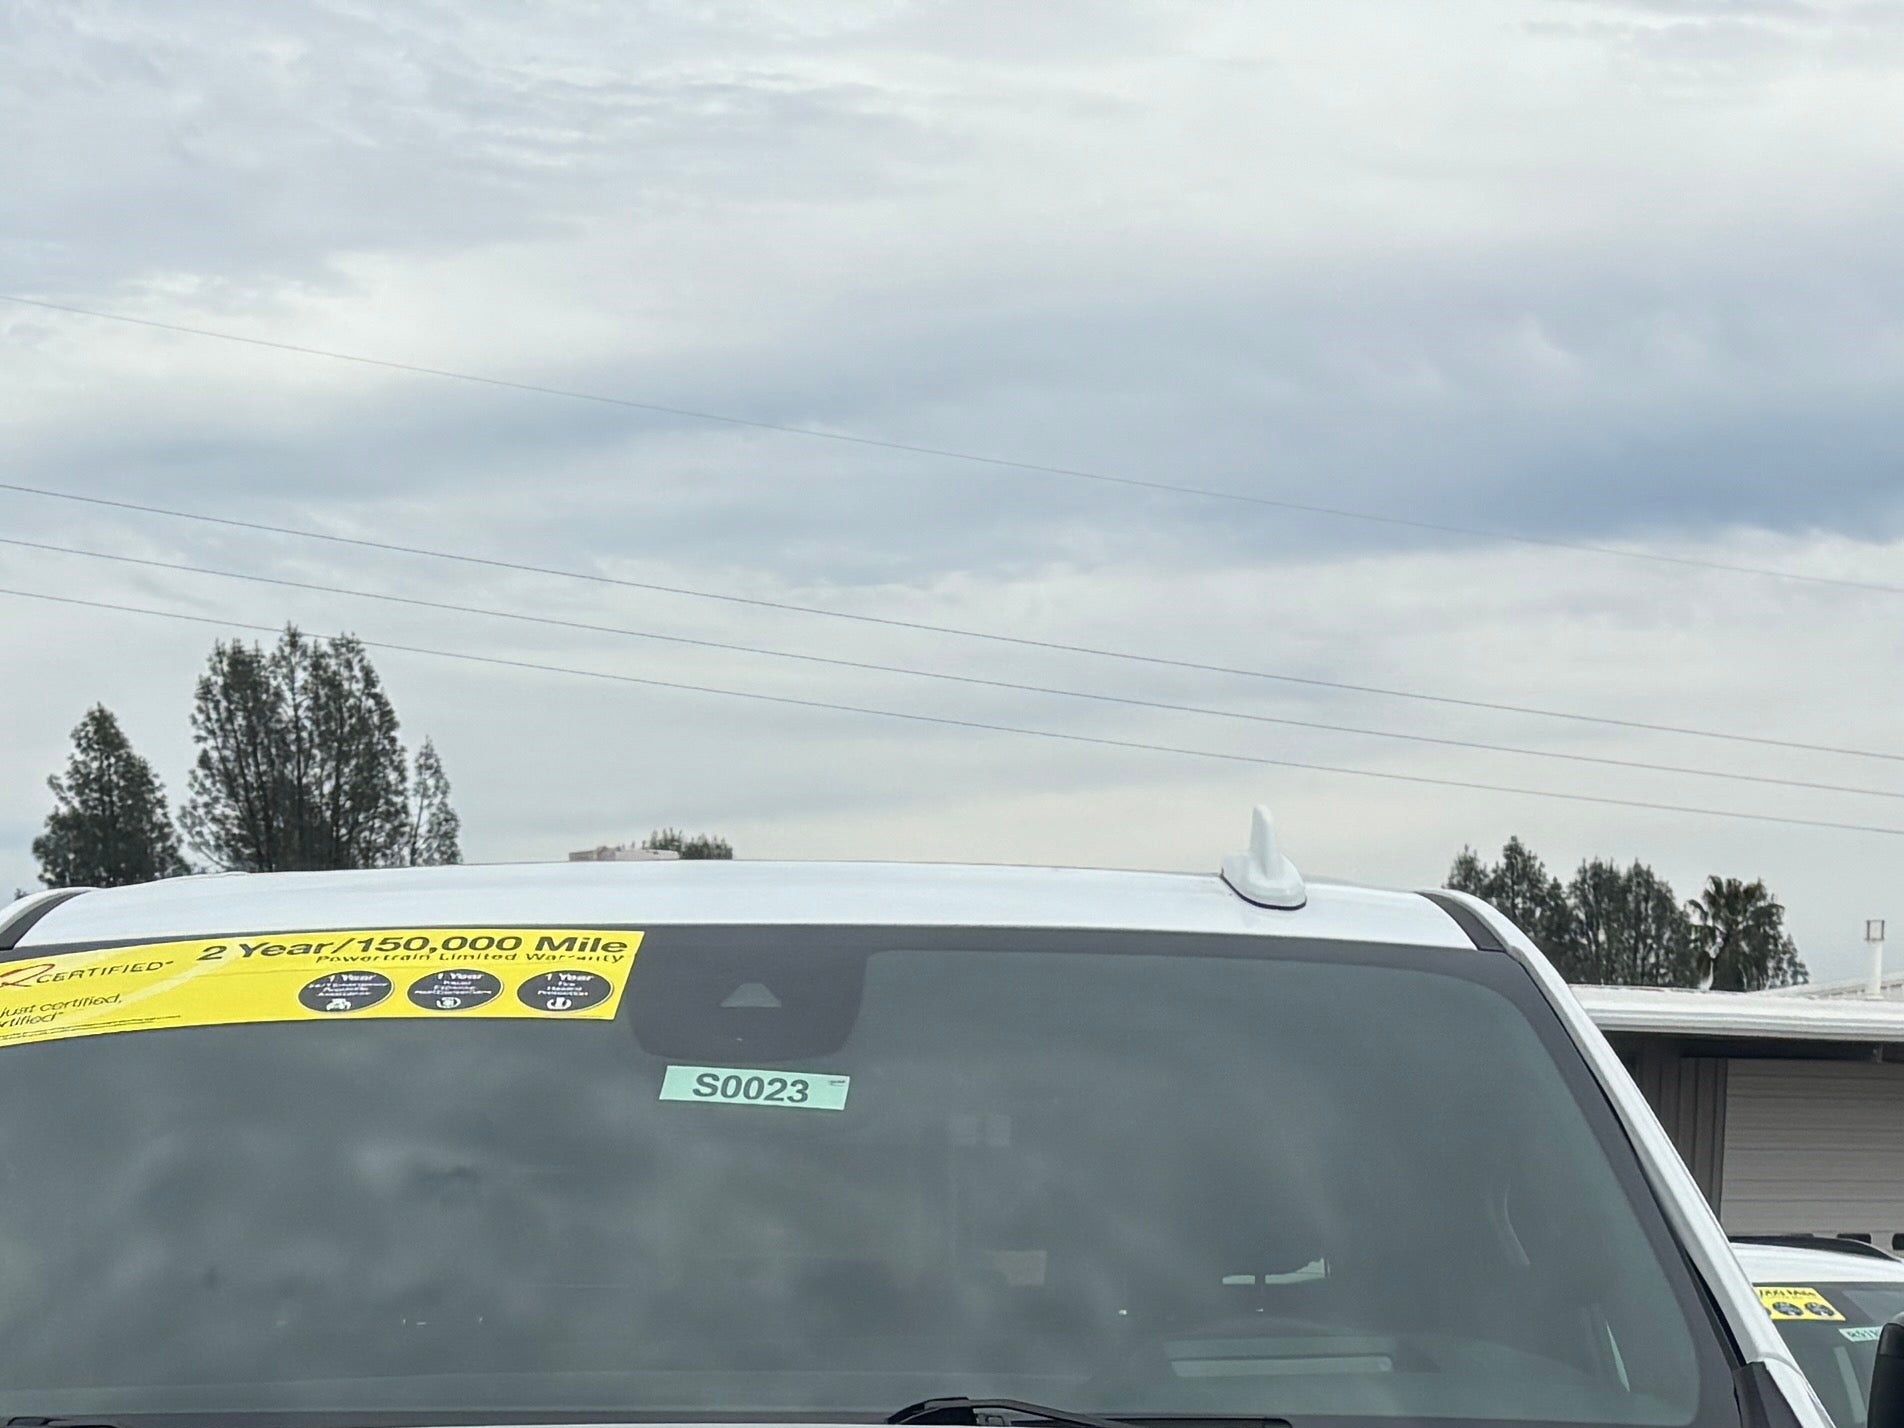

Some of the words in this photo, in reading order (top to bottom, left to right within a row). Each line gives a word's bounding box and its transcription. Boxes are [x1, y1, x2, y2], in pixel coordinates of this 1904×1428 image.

[196, 945, 228, 961] 2
[239, 936, 523, 958] Year/150,000
[535, 936, 629, 953] Mile
[439, 952, 517, 961] Limited
[692, 1073, 809, 1103] S0023
